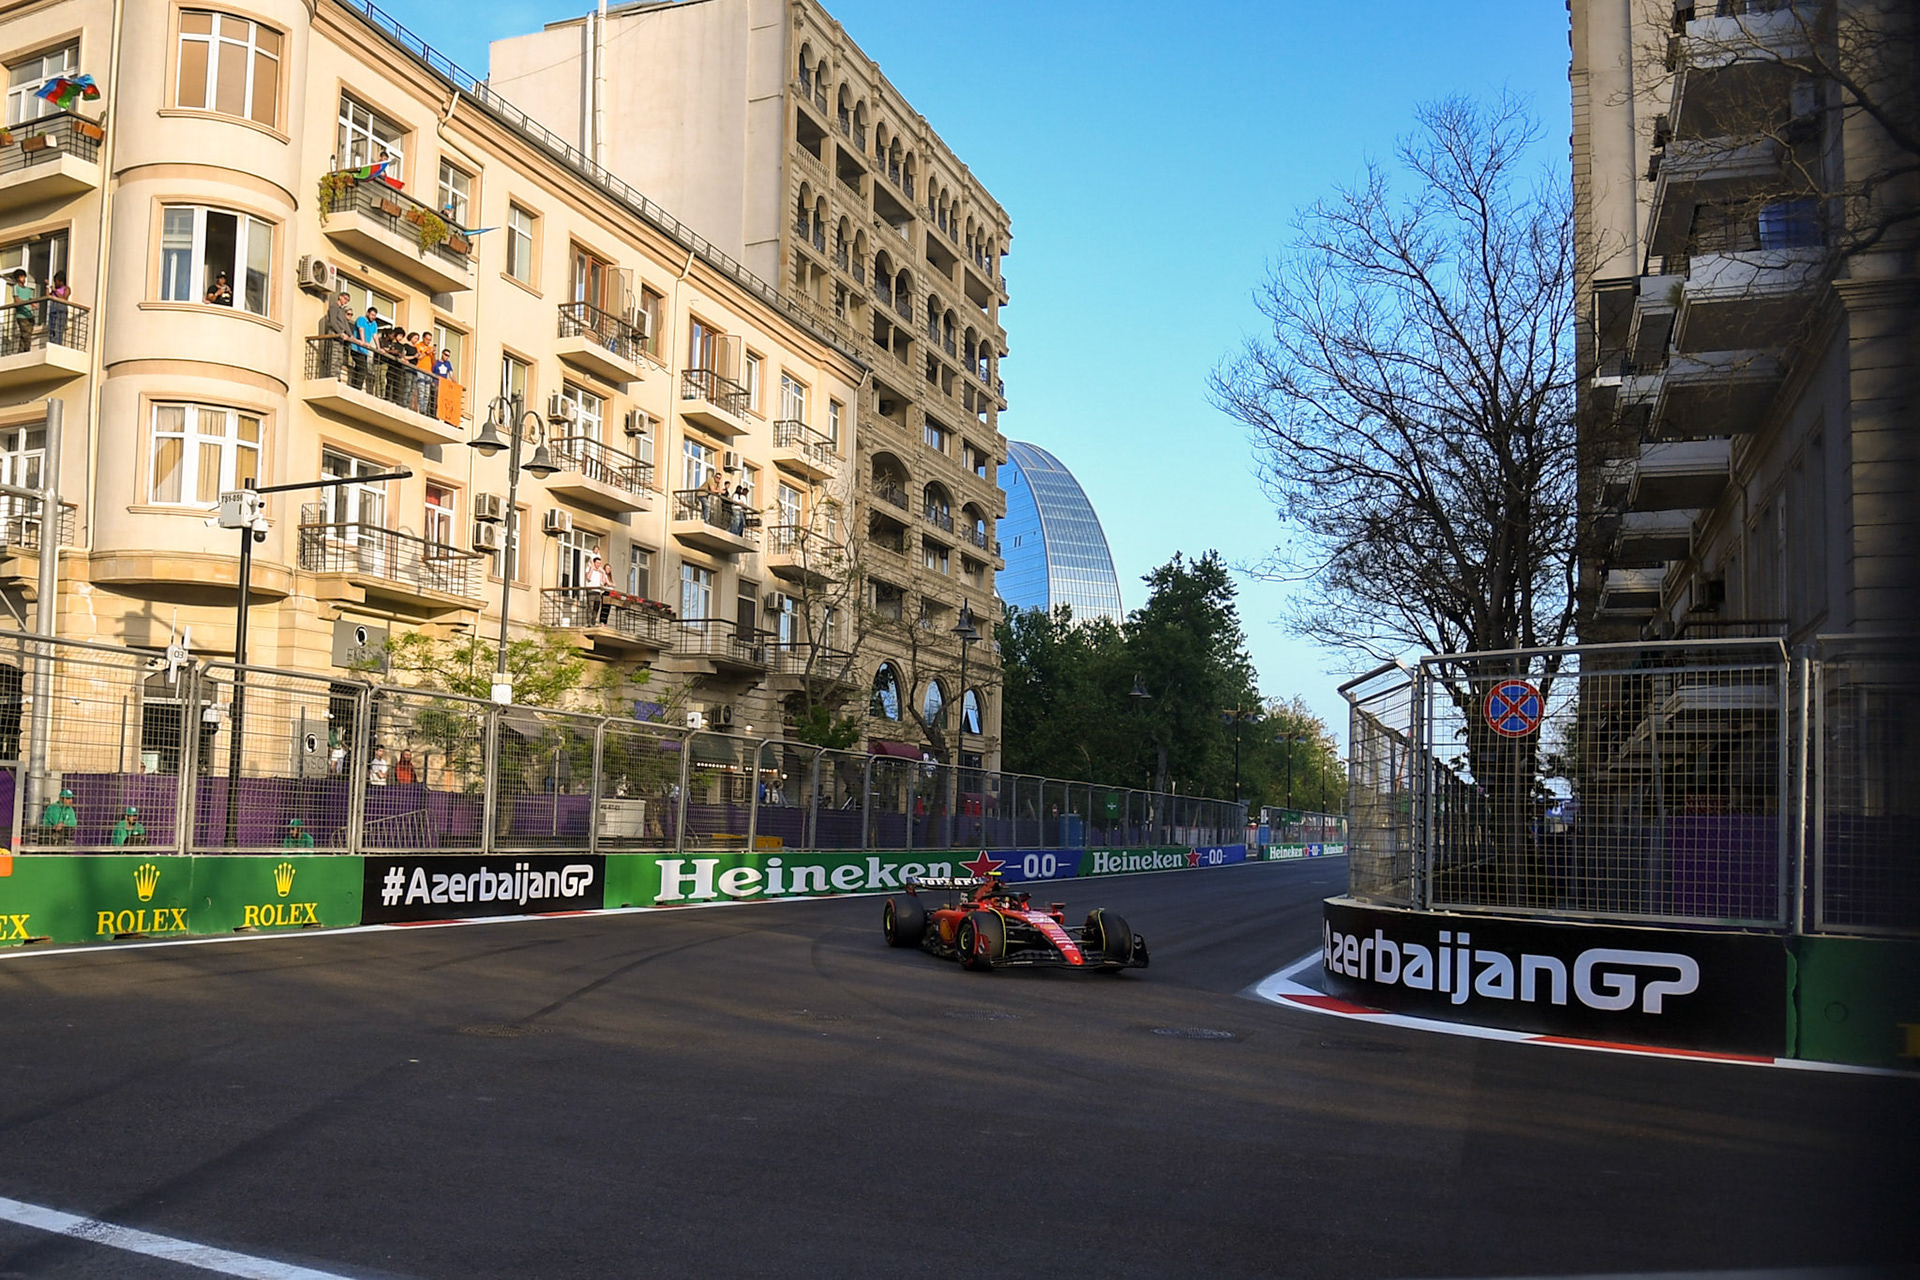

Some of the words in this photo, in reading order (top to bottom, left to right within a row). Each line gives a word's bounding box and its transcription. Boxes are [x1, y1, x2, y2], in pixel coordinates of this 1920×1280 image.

[1092, 850, 1183, 873] Heineken
[1269, 845, 1303, 860] Heineken
[381, 862, 593, 906] #AzerbaijanGP
[653, 856, 951, 902] Heineken
[96, 908, 188, 935] ROLEX
[243, 902, 318, 927] ROLEX
[1323, 918, 1700, 1015] AzerbaijanGP
